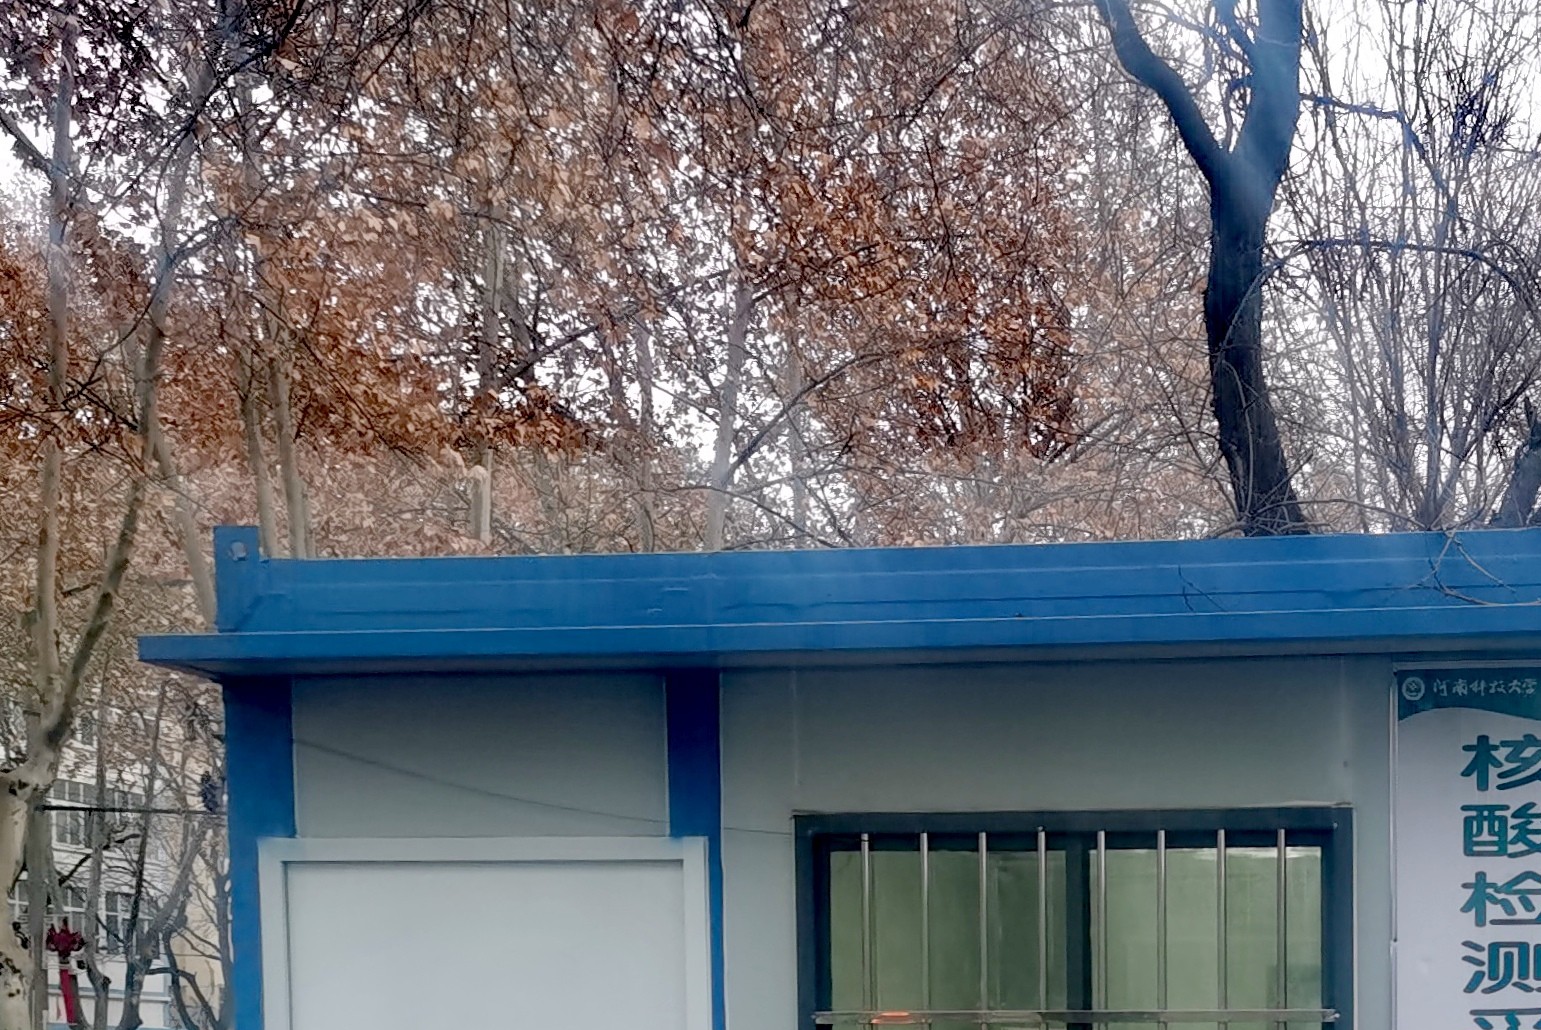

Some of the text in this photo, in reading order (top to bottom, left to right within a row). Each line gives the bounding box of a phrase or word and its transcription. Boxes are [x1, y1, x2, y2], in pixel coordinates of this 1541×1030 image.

[1432, 678, 1538, 697] 河南科技大学
